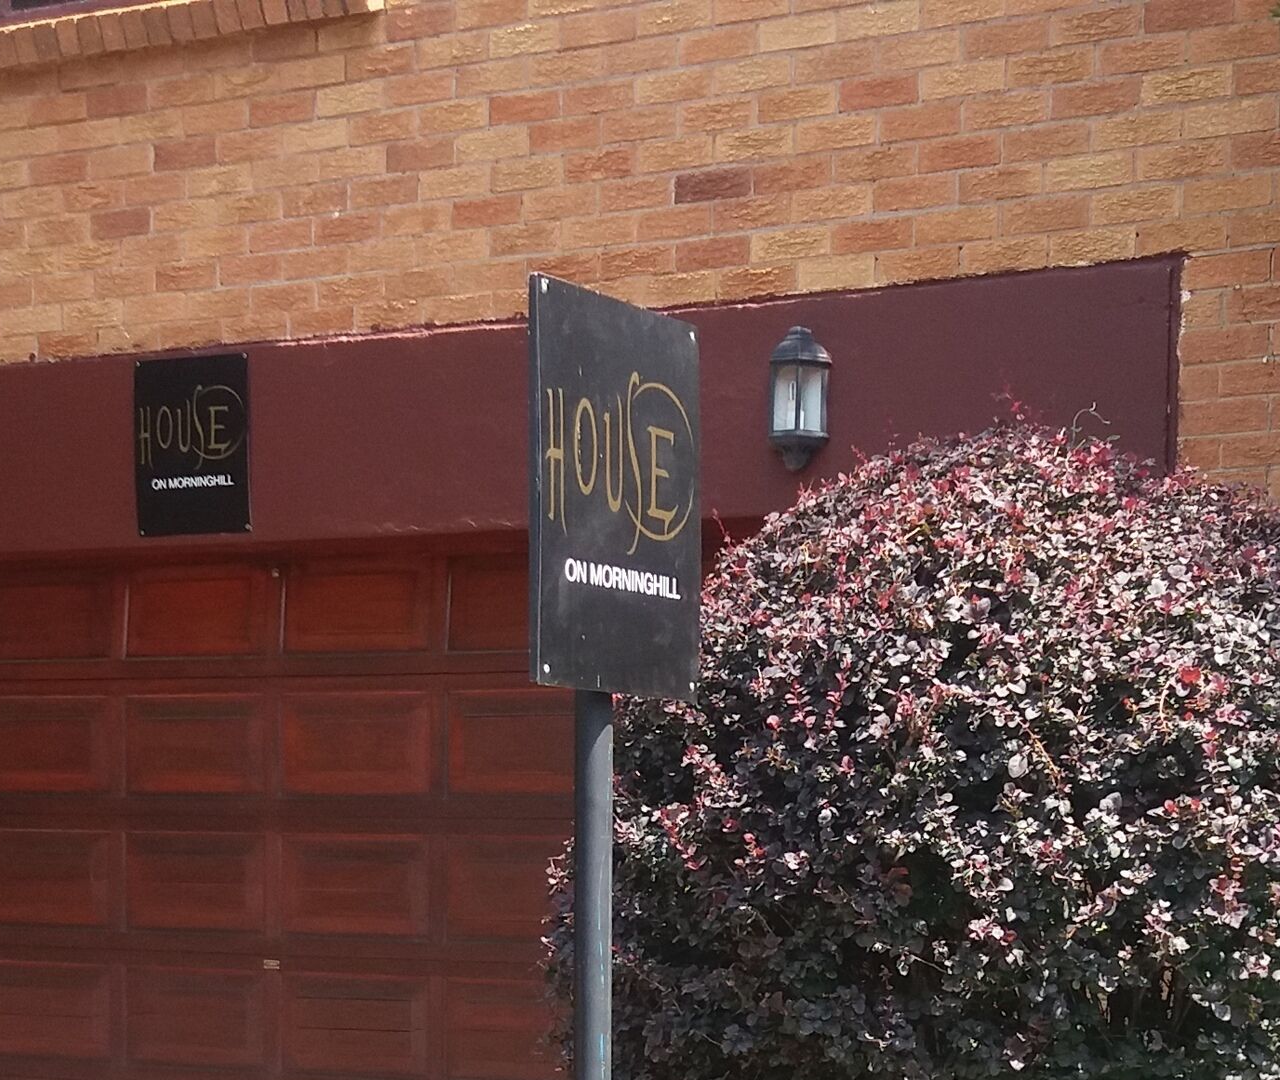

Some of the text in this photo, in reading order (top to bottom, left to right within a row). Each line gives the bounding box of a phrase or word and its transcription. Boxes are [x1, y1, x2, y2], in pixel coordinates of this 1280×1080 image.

[139, 385, 245, 470] HOUSE
[151, 474, 234, 490] ON MORNINGHILL
[545, 370, 695, 556] HOUSE
[564, 557, 682, 600] ON MORNINGHILL
